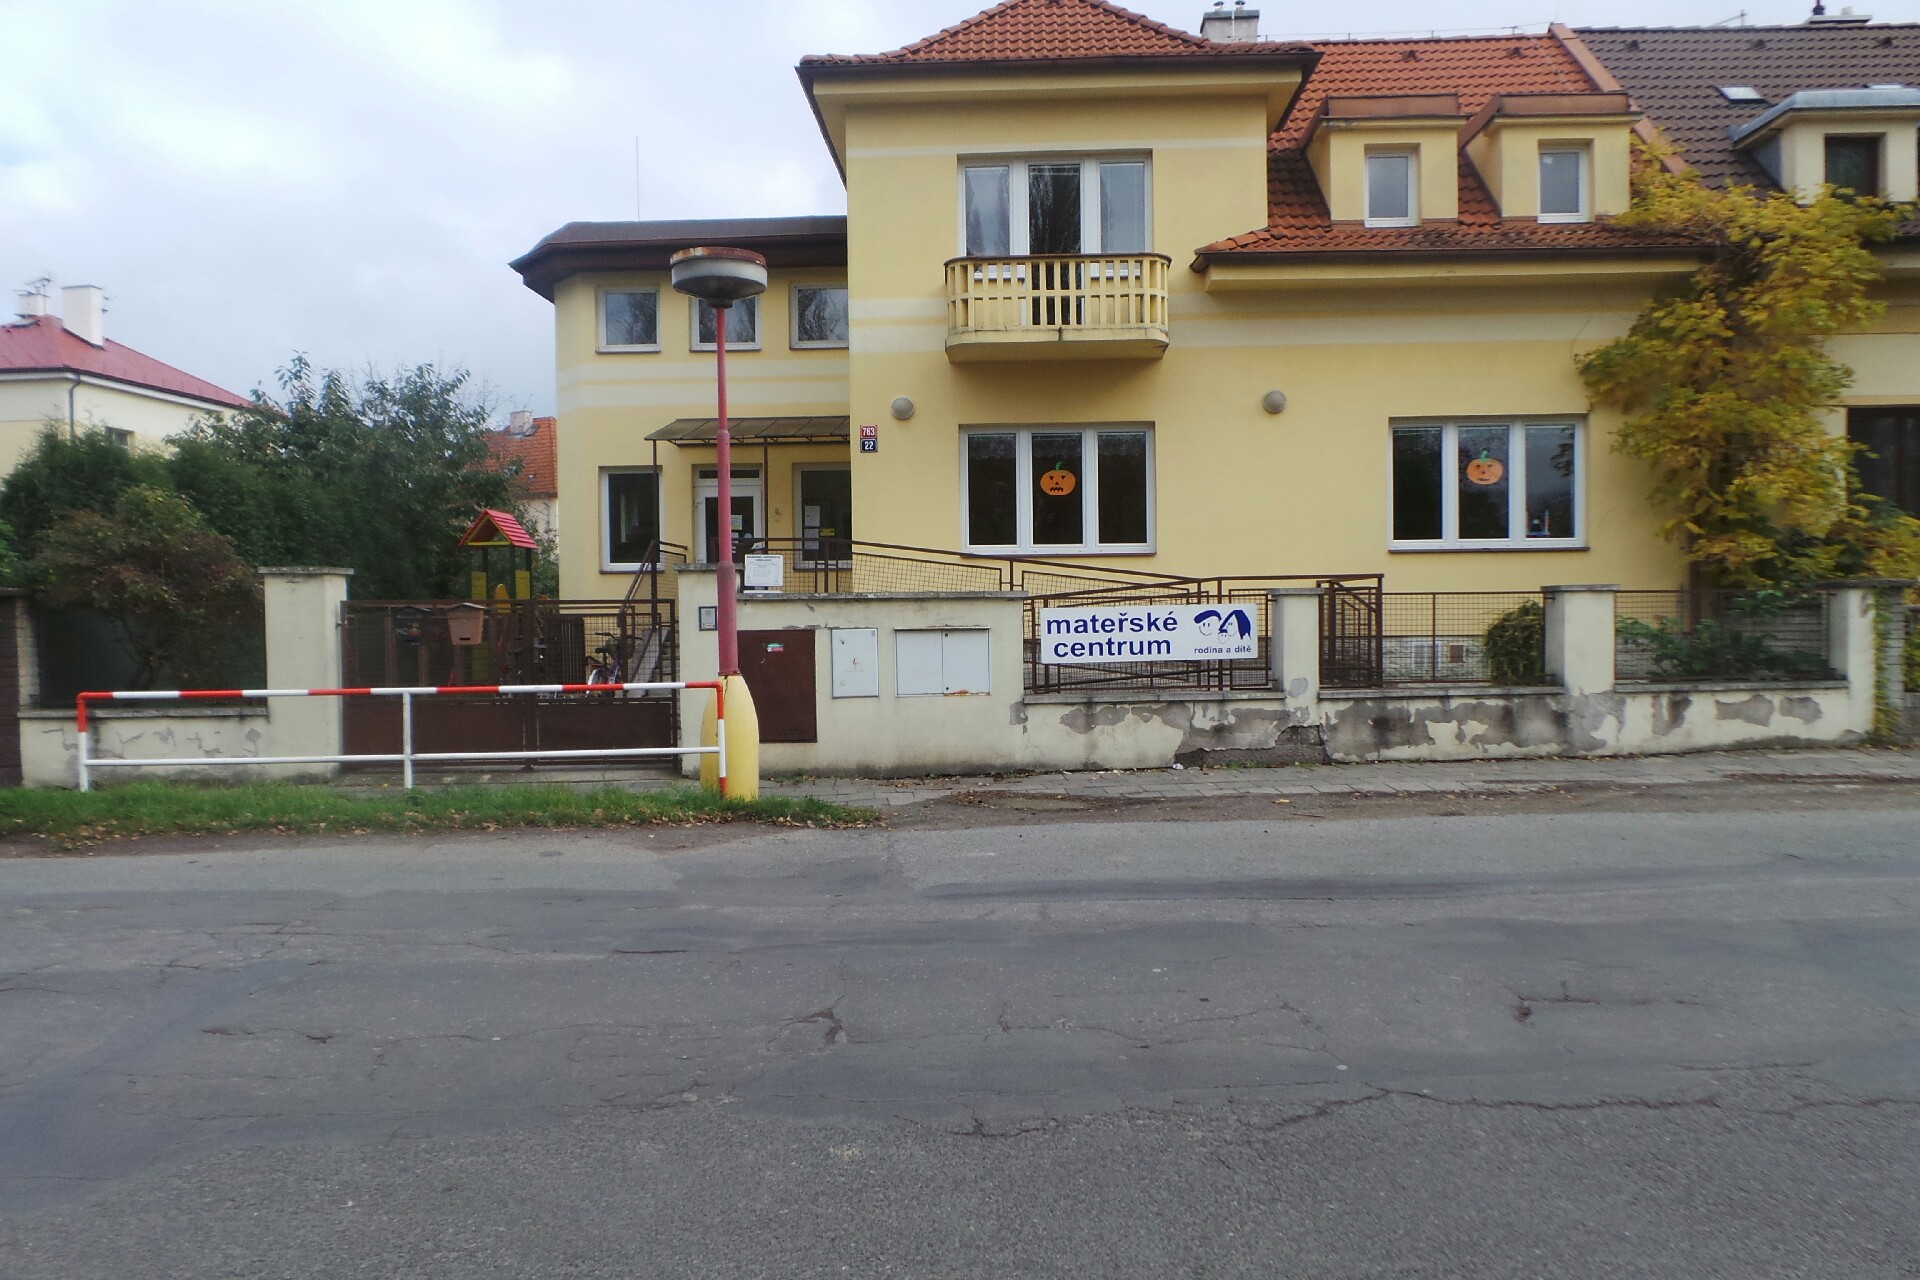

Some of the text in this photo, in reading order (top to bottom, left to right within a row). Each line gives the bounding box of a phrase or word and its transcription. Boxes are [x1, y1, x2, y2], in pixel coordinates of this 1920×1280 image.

[862, 427, 875, 436] 763
[864, 441, 874, 450] 22
[1046, 611, 1178, 634] mateřské
[1053, 637, 1171, 658] centrum
[1194, 646, 1223, 654] rodina
